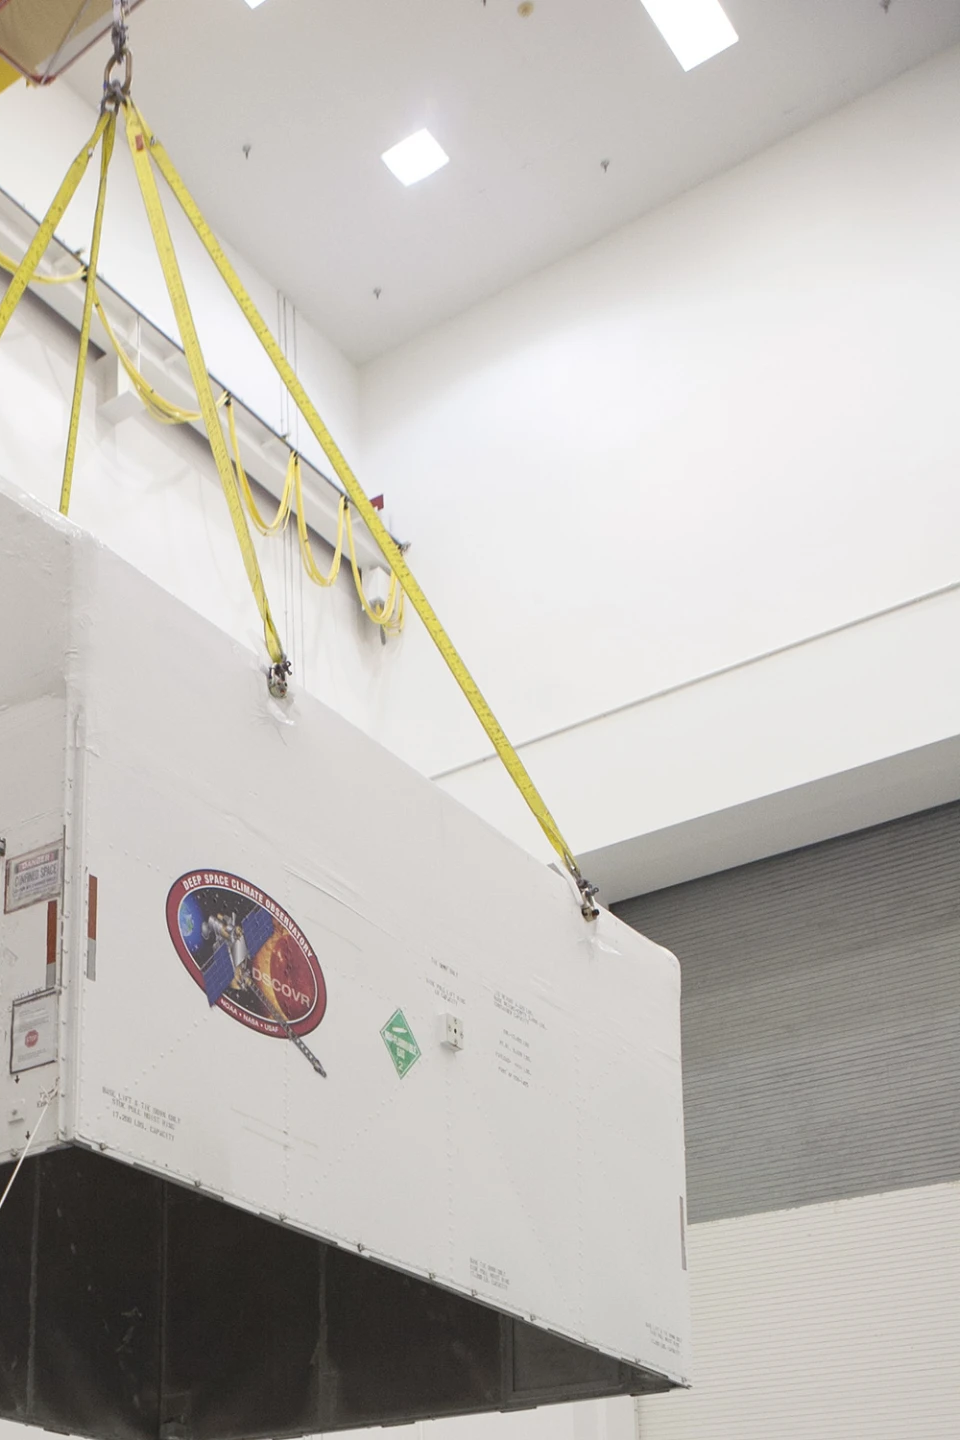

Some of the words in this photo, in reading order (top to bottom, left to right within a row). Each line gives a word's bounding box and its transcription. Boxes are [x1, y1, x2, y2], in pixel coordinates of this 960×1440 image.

[40, 862, 57, 878] SPACE
[182, 874, 202, 891] DEEP
[204, 873, 229, 887] SPACE
[231, 878, 263, 904] CLIMATE
[265, 899, 313, 958] OBSERVATORY
[252, 967, 311, 1008] DSCOVR
[220, 998, 238, 1015] NOAA
[243, 1013, 259, 1027] NASA
[264, 1023, 279, 1033] USAF
[398, 1060, 404, 1072] 2
